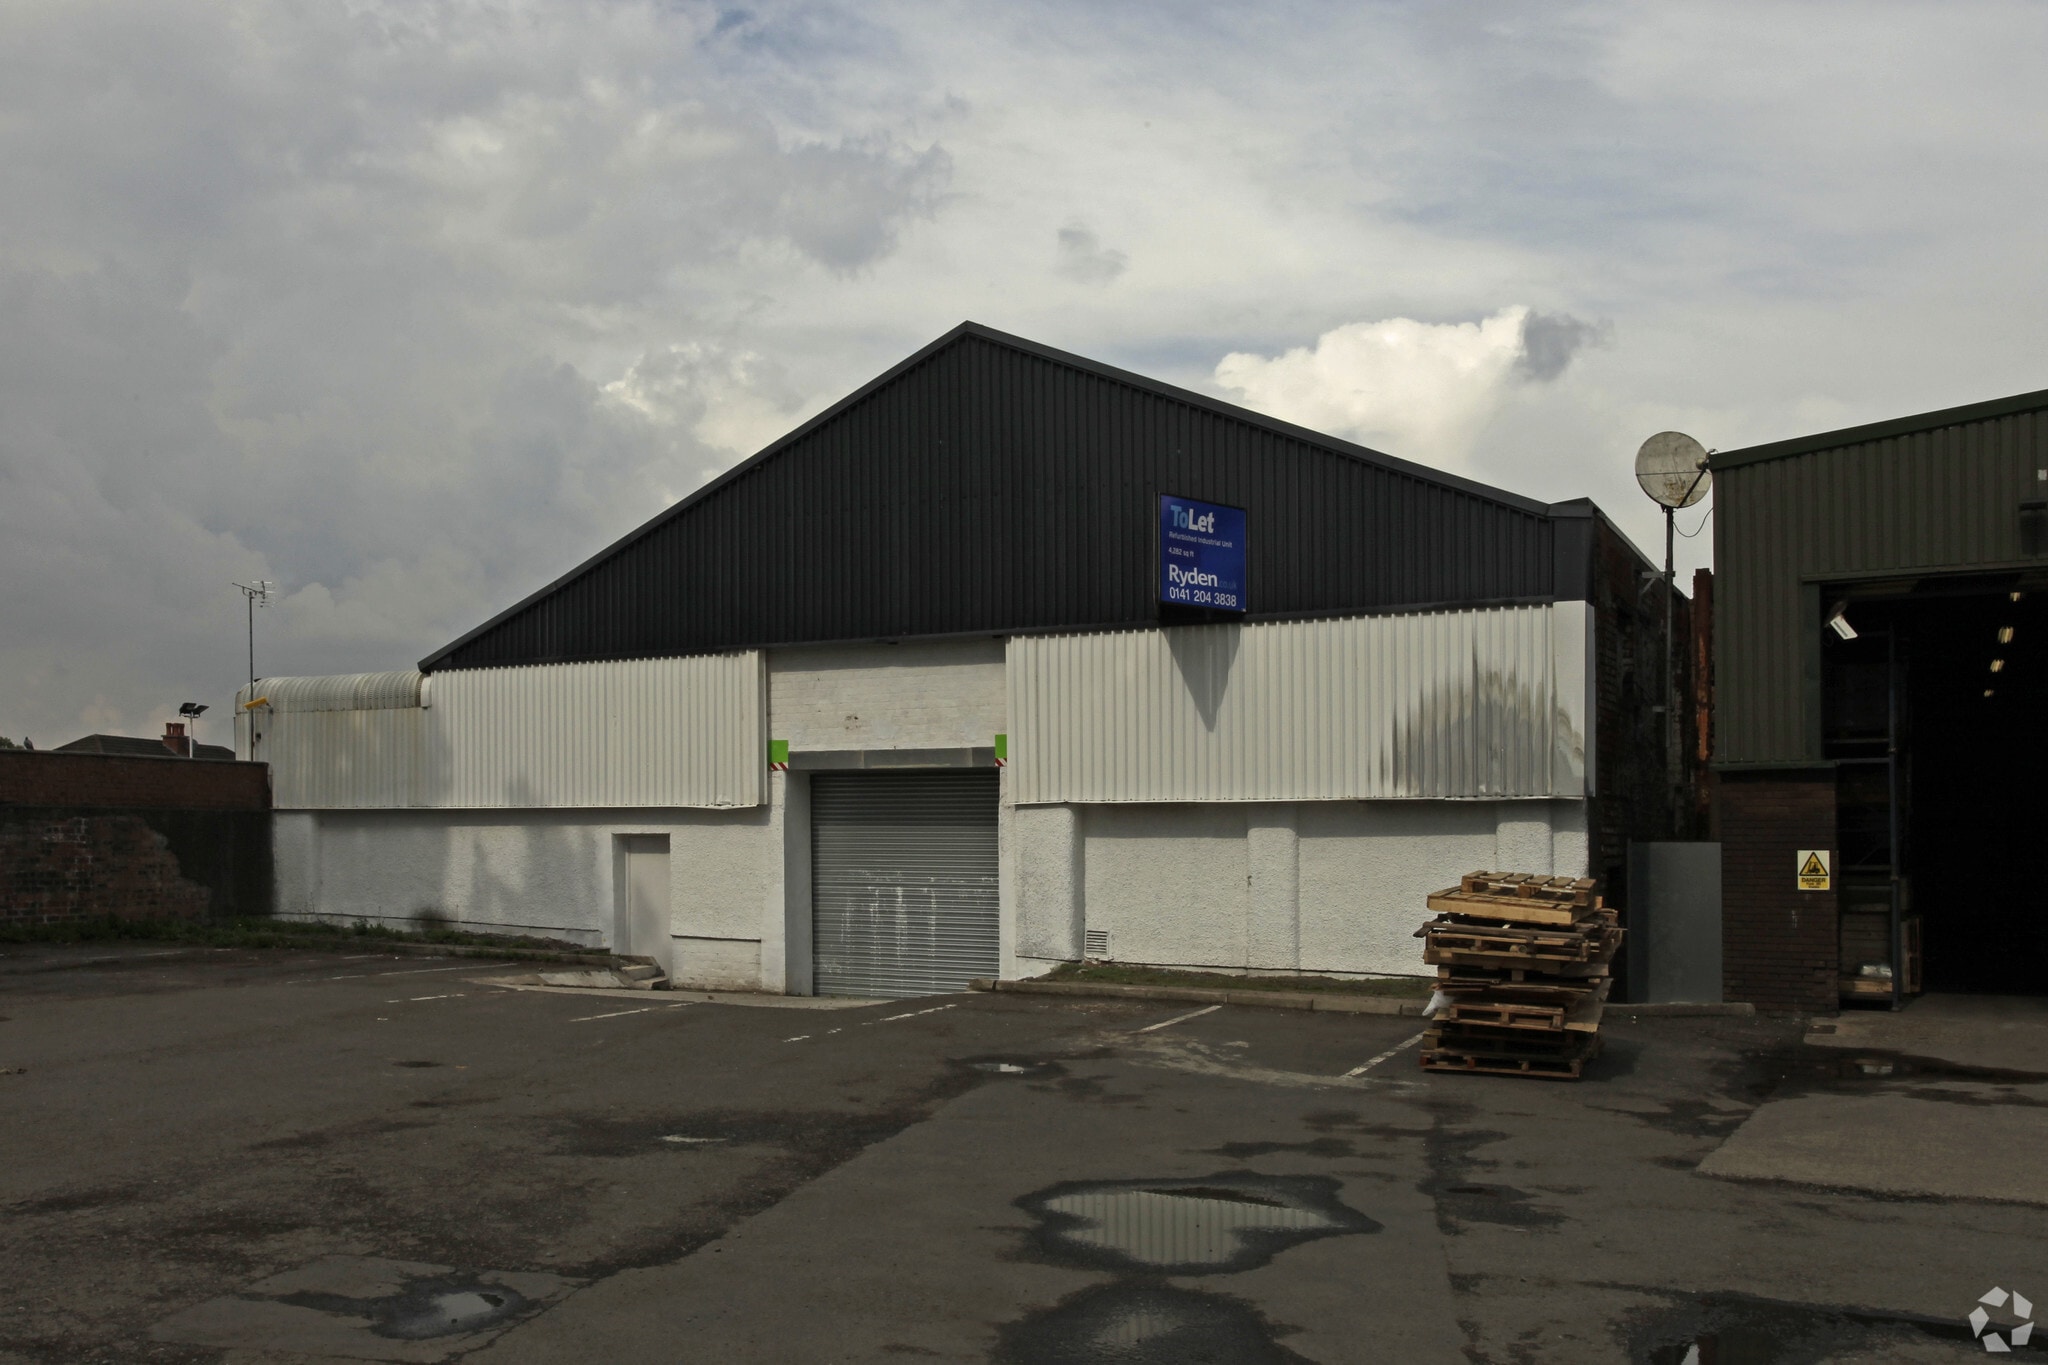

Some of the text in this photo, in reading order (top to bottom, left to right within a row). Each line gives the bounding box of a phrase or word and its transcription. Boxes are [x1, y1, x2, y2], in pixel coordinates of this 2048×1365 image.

[1169, 587, 1237, 607] 0141 204 3838
